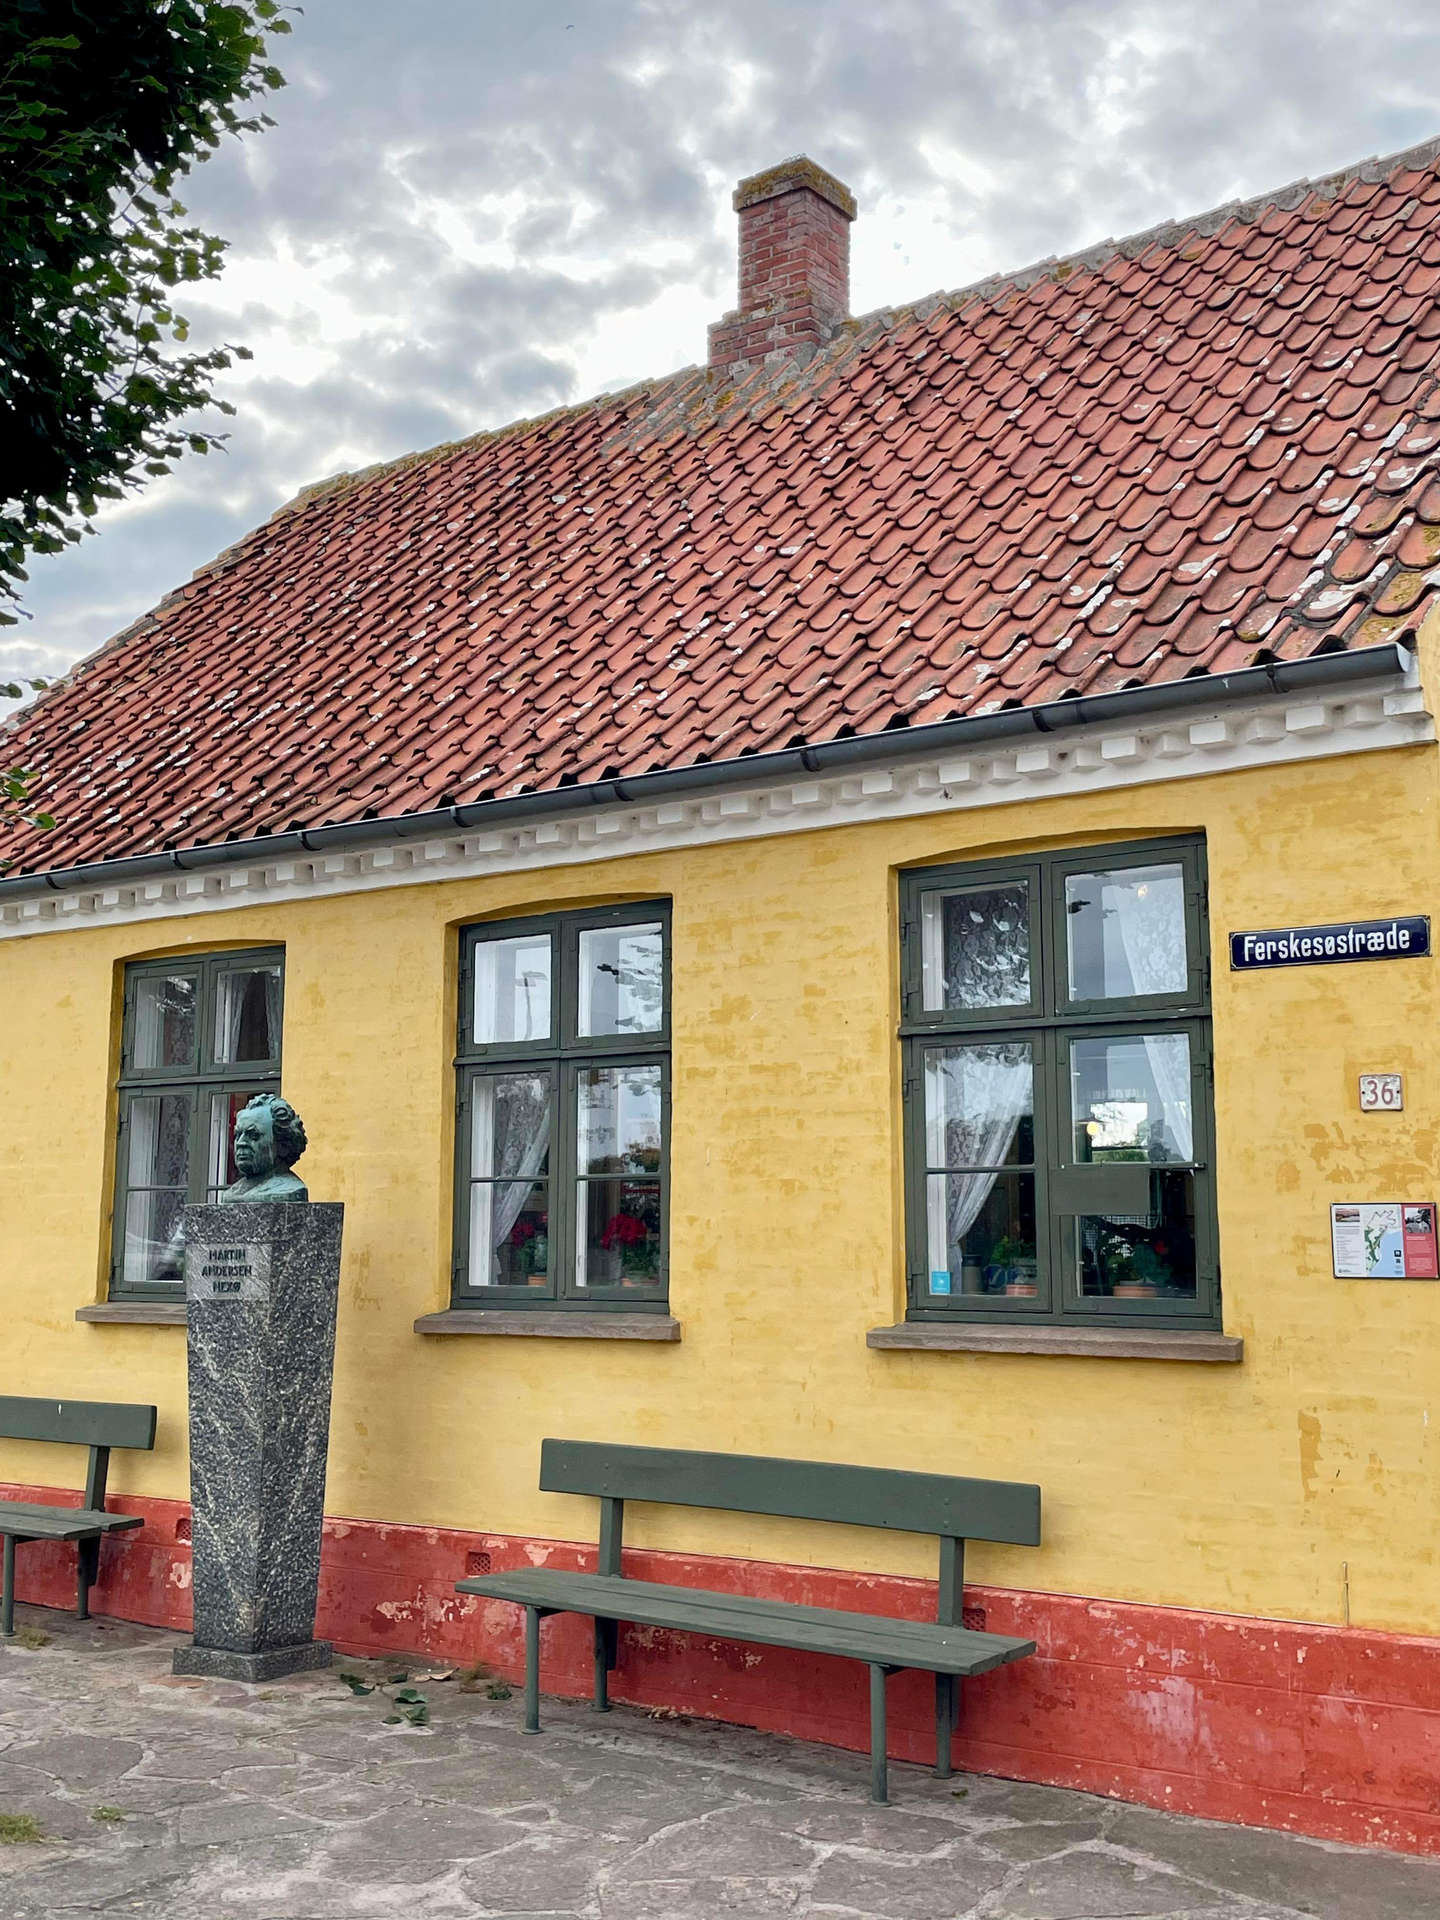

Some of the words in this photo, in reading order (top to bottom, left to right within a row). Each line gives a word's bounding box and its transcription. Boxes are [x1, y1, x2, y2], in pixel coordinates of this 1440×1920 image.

[1244, 922, 1410, 962] Ferskesøstræde
[1366, 1080, 1393, 1105] 36
[209, 1249, 246, 1261] MARTIN
[201, 1265, 252, 1276] ANDERSEN
